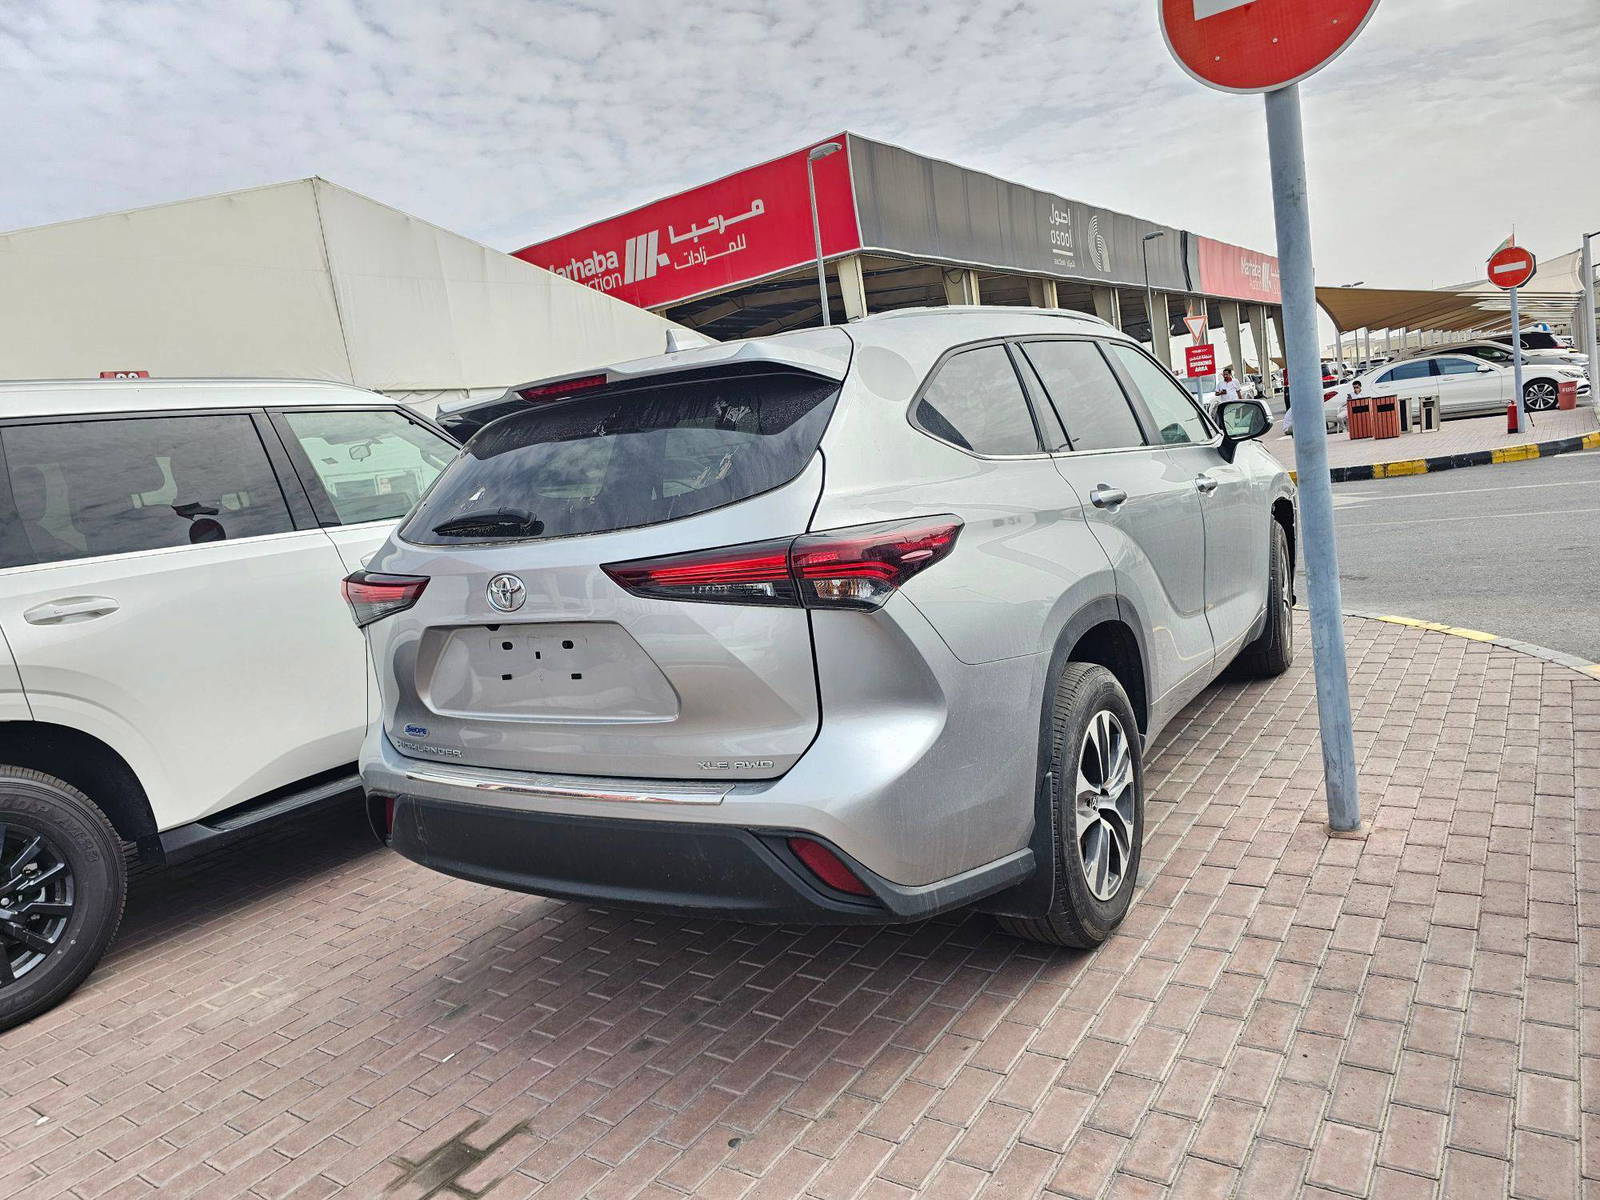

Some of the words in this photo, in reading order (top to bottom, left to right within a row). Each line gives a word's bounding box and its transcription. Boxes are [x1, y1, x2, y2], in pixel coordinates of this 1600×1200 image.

[668, 198, 765, 245] مرحبا
[674, 232, 747, 270] للمزادات
[697, 760, 729, 770] XLE
[734, 760, 776, 769] AWD
